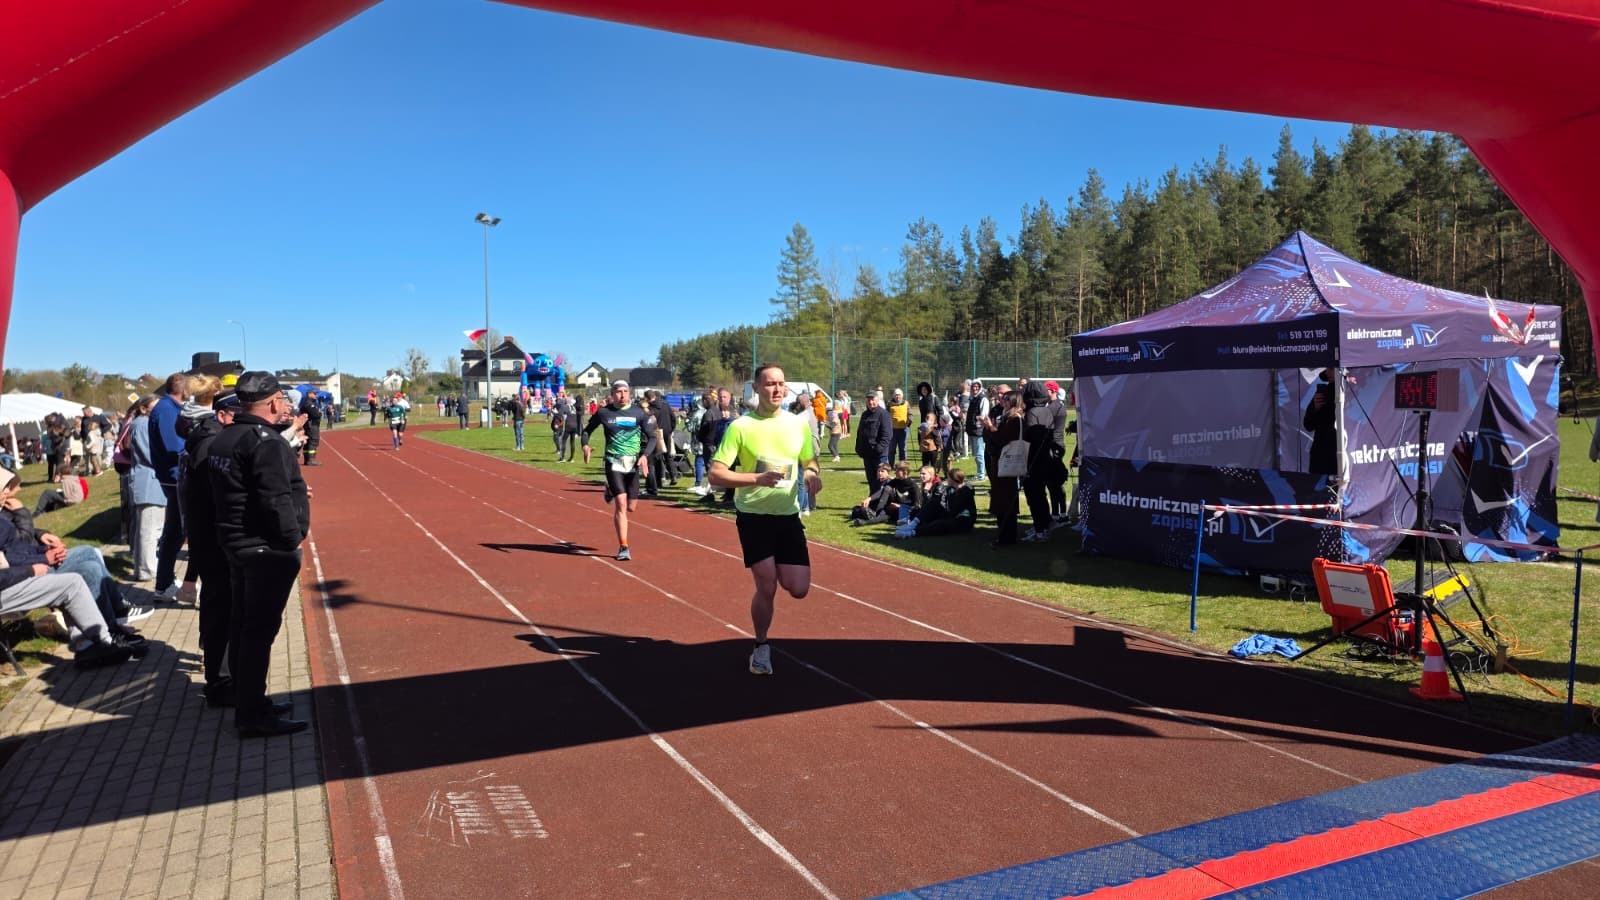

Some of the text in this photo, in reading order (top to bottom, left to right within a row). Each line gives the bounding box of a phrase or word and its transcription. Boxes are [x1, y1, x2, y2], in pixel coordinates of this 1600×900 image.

[1289, 331, 1302, 339] 519
[1303, 330, 1314, 339] 121
[1315, 329, 1328, 338] 199
[1346, 328, 1402, 340] elektroniczne
[1376, 336, 1414, 349] zapisy.pl
[1078, 346, 1129, 357] elektroniczne
[1232, 343, 1328, 354] biuro@elektronicznezapisy.pl
[1099, 489, 1200, 514] elektroniczne
